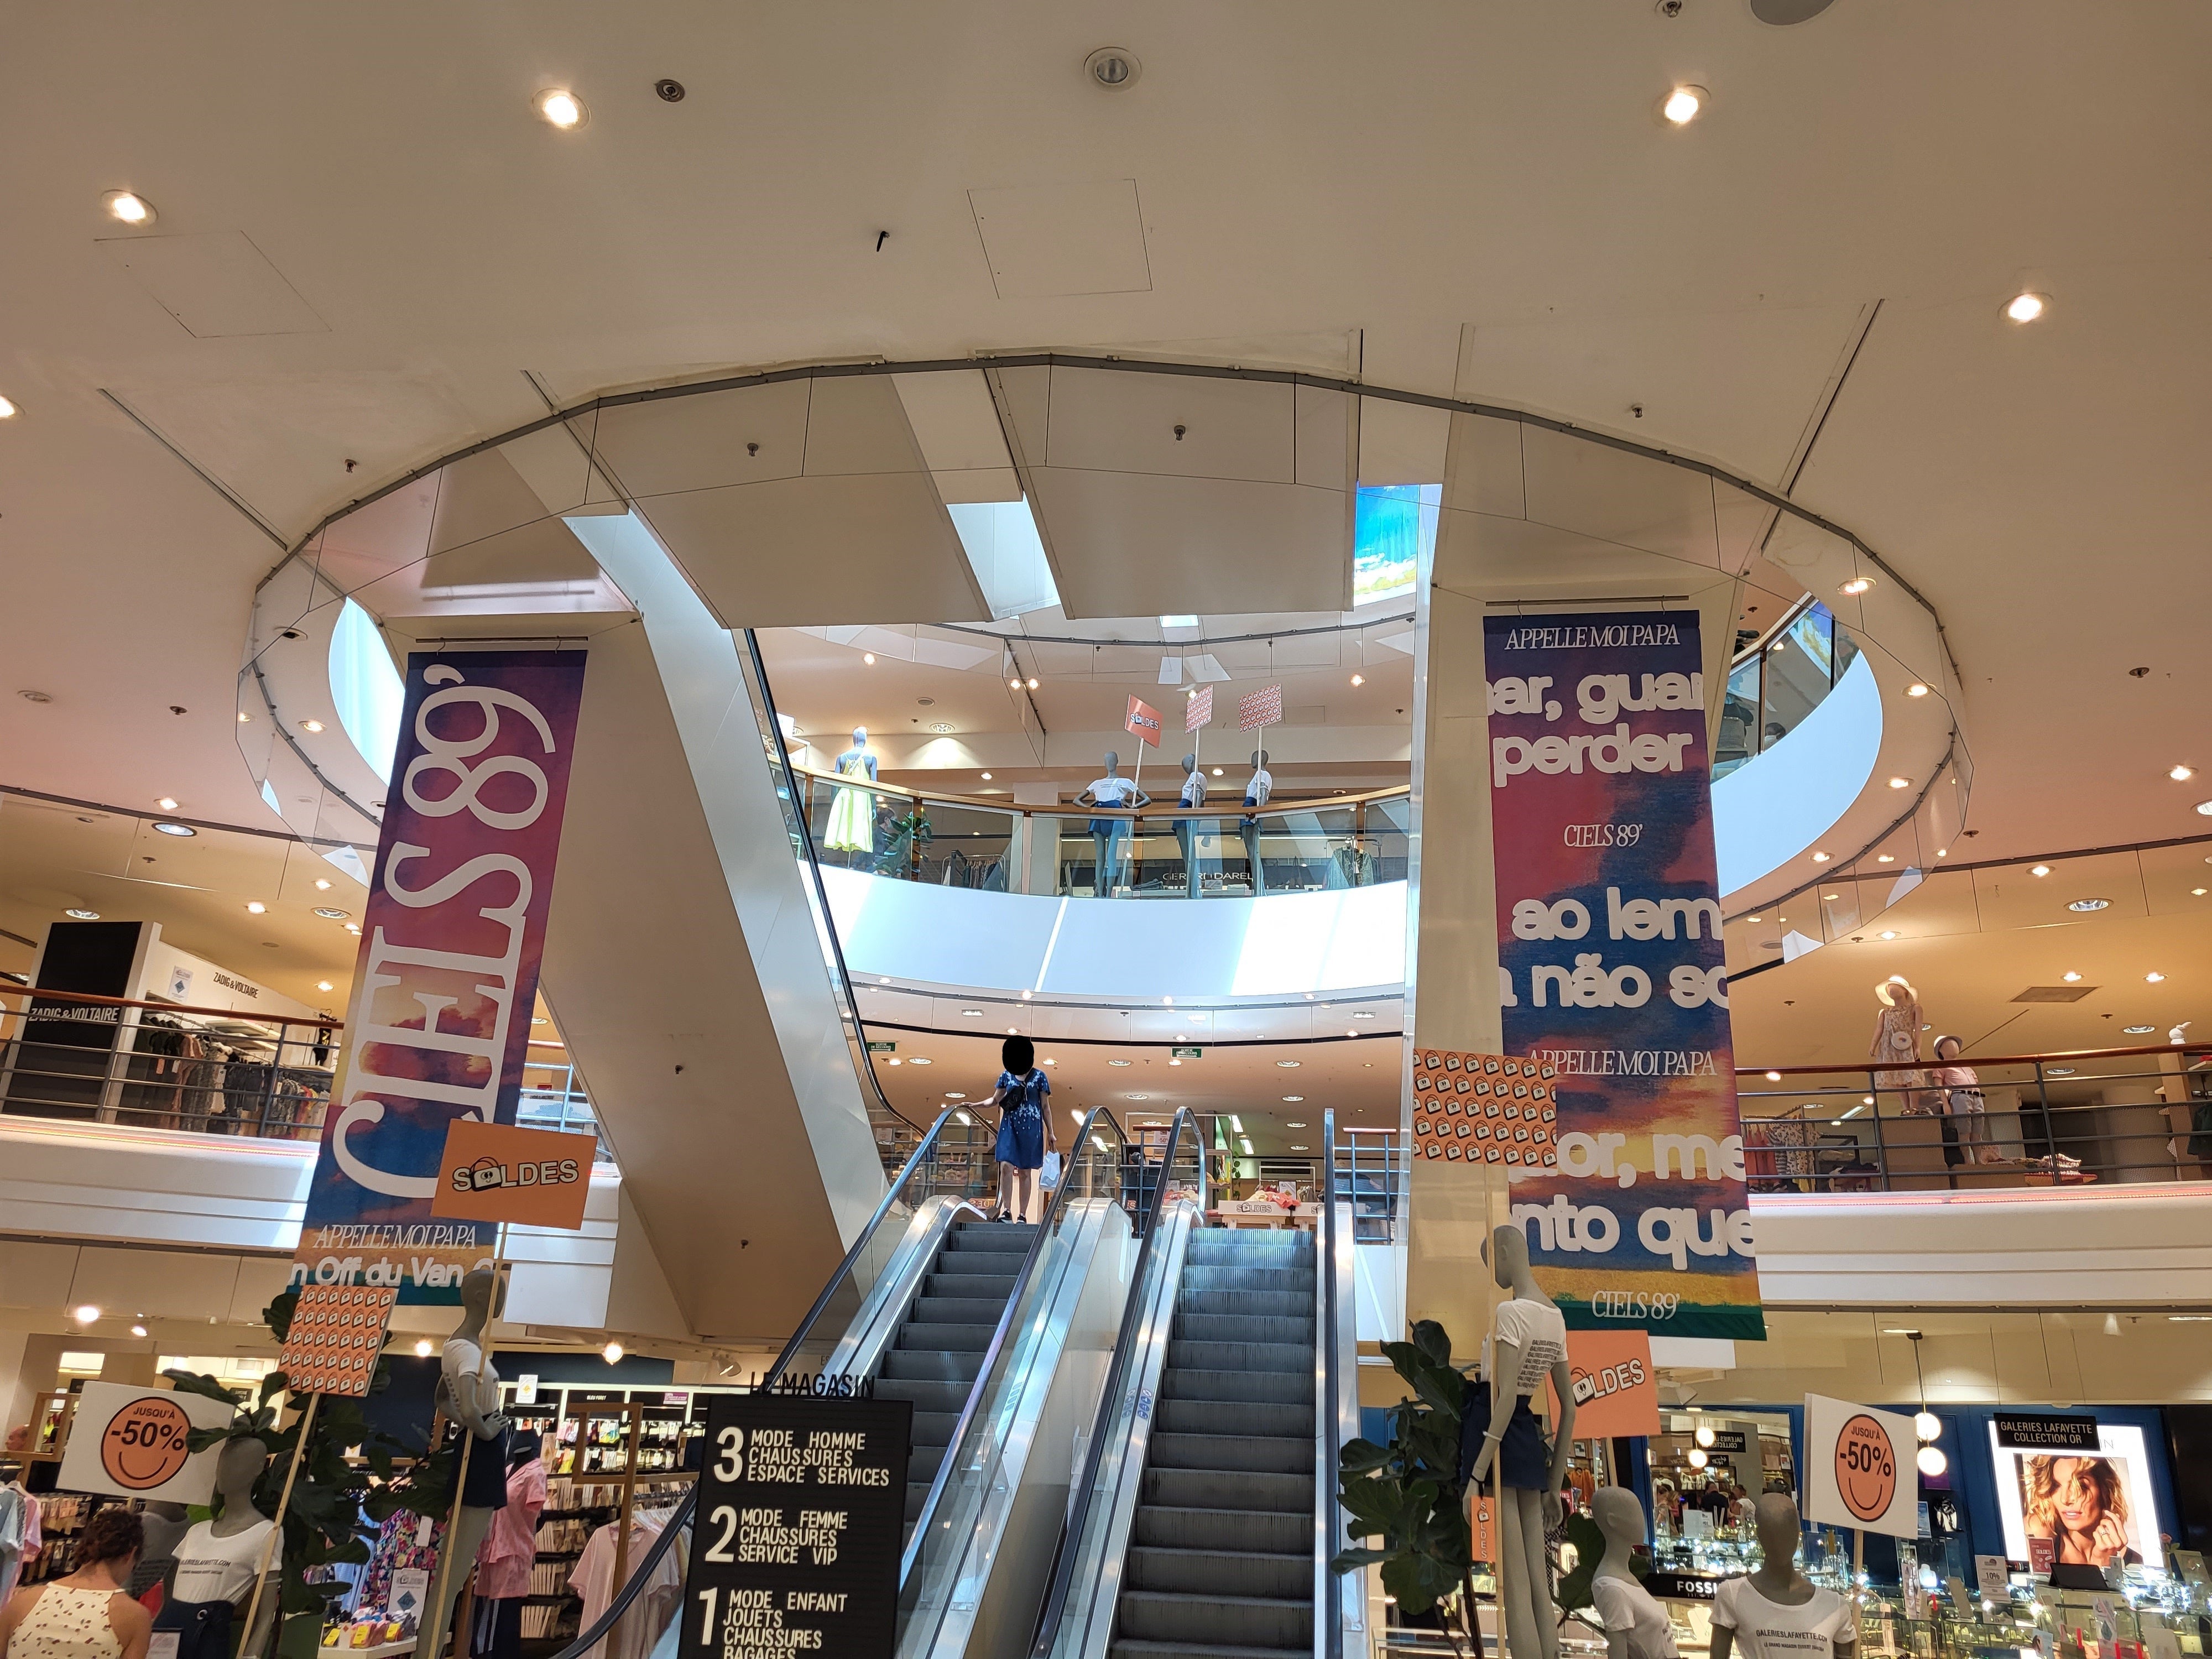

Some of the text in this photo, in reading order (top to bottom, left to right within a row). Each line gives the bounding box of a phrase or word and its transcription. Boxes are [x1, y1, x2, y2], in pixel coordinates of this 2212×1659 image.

[1486, 676, 1562, 721] ar,
[1130, 712, 1159, 730] SOLDES
[1493, 723, 1693, 787] perder
[1564, 824, 1614, 847] CIELS
[1214, 872, 1253, 880] DAREL
[1512, 899, 1592, 940] ao
[332, 840, 533, 1199] CIELS
[1509, 1132, 1637, 1188] or,
[452, 1157, 580, 1192] SOLDES
[1237, 1202, 1272, 1213] SOLDES
[1638, 1207, 1756, 1270] que
[315, 1256, 363, 1287] Off
[365, 1257, 404, 1287] du
[411, 1257, 464, 1288] Van
[1592, 1290, 1649, 1319] CIELS
[780, 1373, 875, 1399] MAGASIN
[1571, 1358, 1646, 1407] OLDES
[133, 1407, 175, 1420] JUSQU'À
[111, 1420, 184, 1451] -50%
[1851, 1426, 1881, 1441] JUSQU'À
[2000, 1421, 2093, 1434] GALERIES LAFAYETTE
[2013, 1432, 2082, 1444] COLLECTION OR
[750, 1430, 866, 1450] MODE HOMME
[713, 1427, 744, 1482] 3
[749, 1447, 853, 1468] CHAUSSURES
[1840, 1441, 1891, 1477] -50%
[748, 1464, 889, 1486] ESPACE SERVICES
[740, 1508, 848, 1530] MODE FEMME
[705, 1505, 738, 1562] 2
[739, 1526, 838, 1547] CHAUSSURES
[738, 1545, 838, 1566] SERVICE VIP
[1677, 1580, 1718, 1594] FOSSI
[729, 1588, 848, 1613] MODE ENFANT
[699, 1587, 718, 1646] 1
[723, 1606, 783, 1629] JOUETS
[723, 1626, 822, 1650] CHAUSSURES
[723, 1645, 796, 1659] BAGAGES
